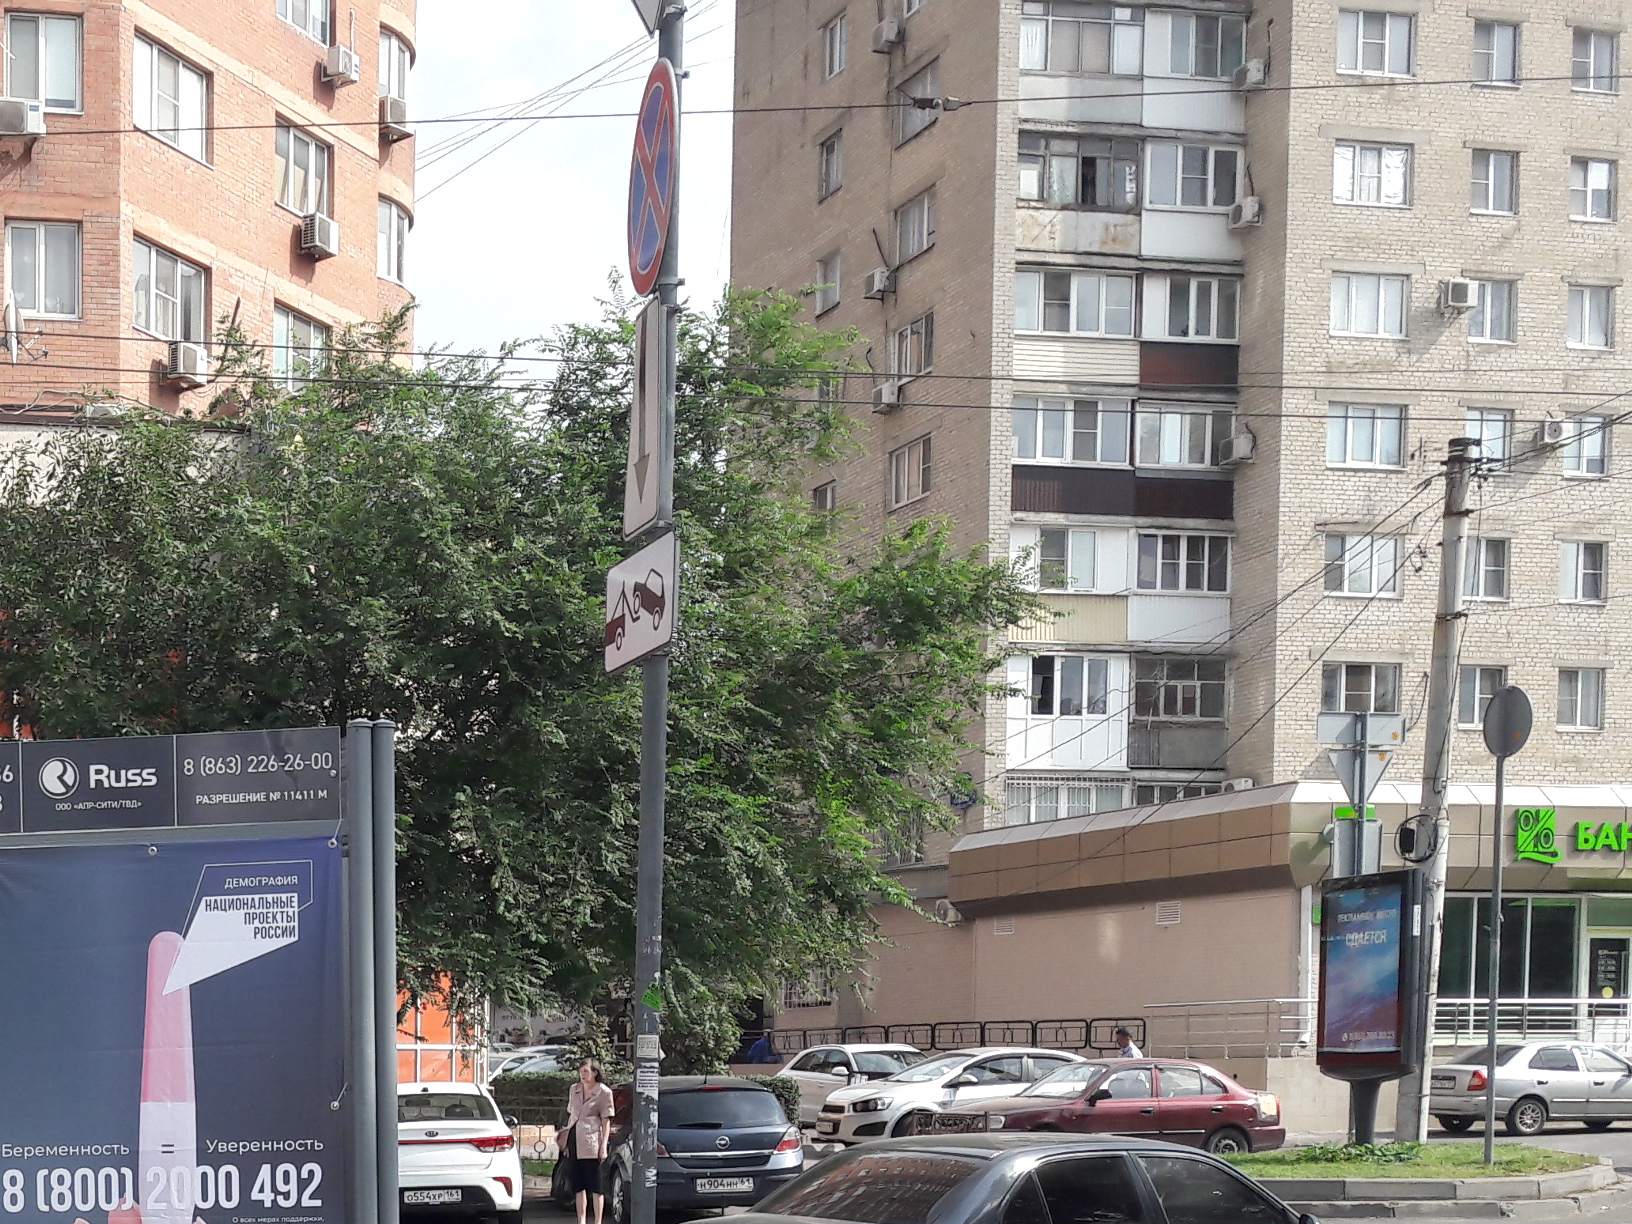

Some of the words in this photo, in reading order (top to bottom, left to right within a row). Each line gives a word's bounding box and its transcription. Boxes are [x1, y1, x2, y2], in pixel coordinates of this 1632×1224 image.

[183, 758, 194, 776] 8
[200, 755, 241, 776] (863)
[247, 752, 333, 773] 226-26-00
[89, 764, 158, 789] Russ
[196, 792, 267, 805] РАЗРЕШЕНИЕ
[269, 791, 281, 801] №
[284, 789, 314, 801] 11411
[55, 803, 72, 811] ООО
[224, 875, 299, 890] ДЕМОГРАФИЯ
[204, 895, 296, 913] НАЦИОНАЛЬНЫЕ
[243, 911, 296, 926] ПРОЕКТЫ
[253, 926, 296, 940] РОССИИ
[1, 1143, 130, 1159] Беременность
[206, 1139, 324, 1155] Уверенность
[2, 1169, 25, 1213] 8
[36, 1167, 134, 1212] (800)
[146, 1164, 240, 1210] 2000
[250, 1162, 323, 1209] 492
